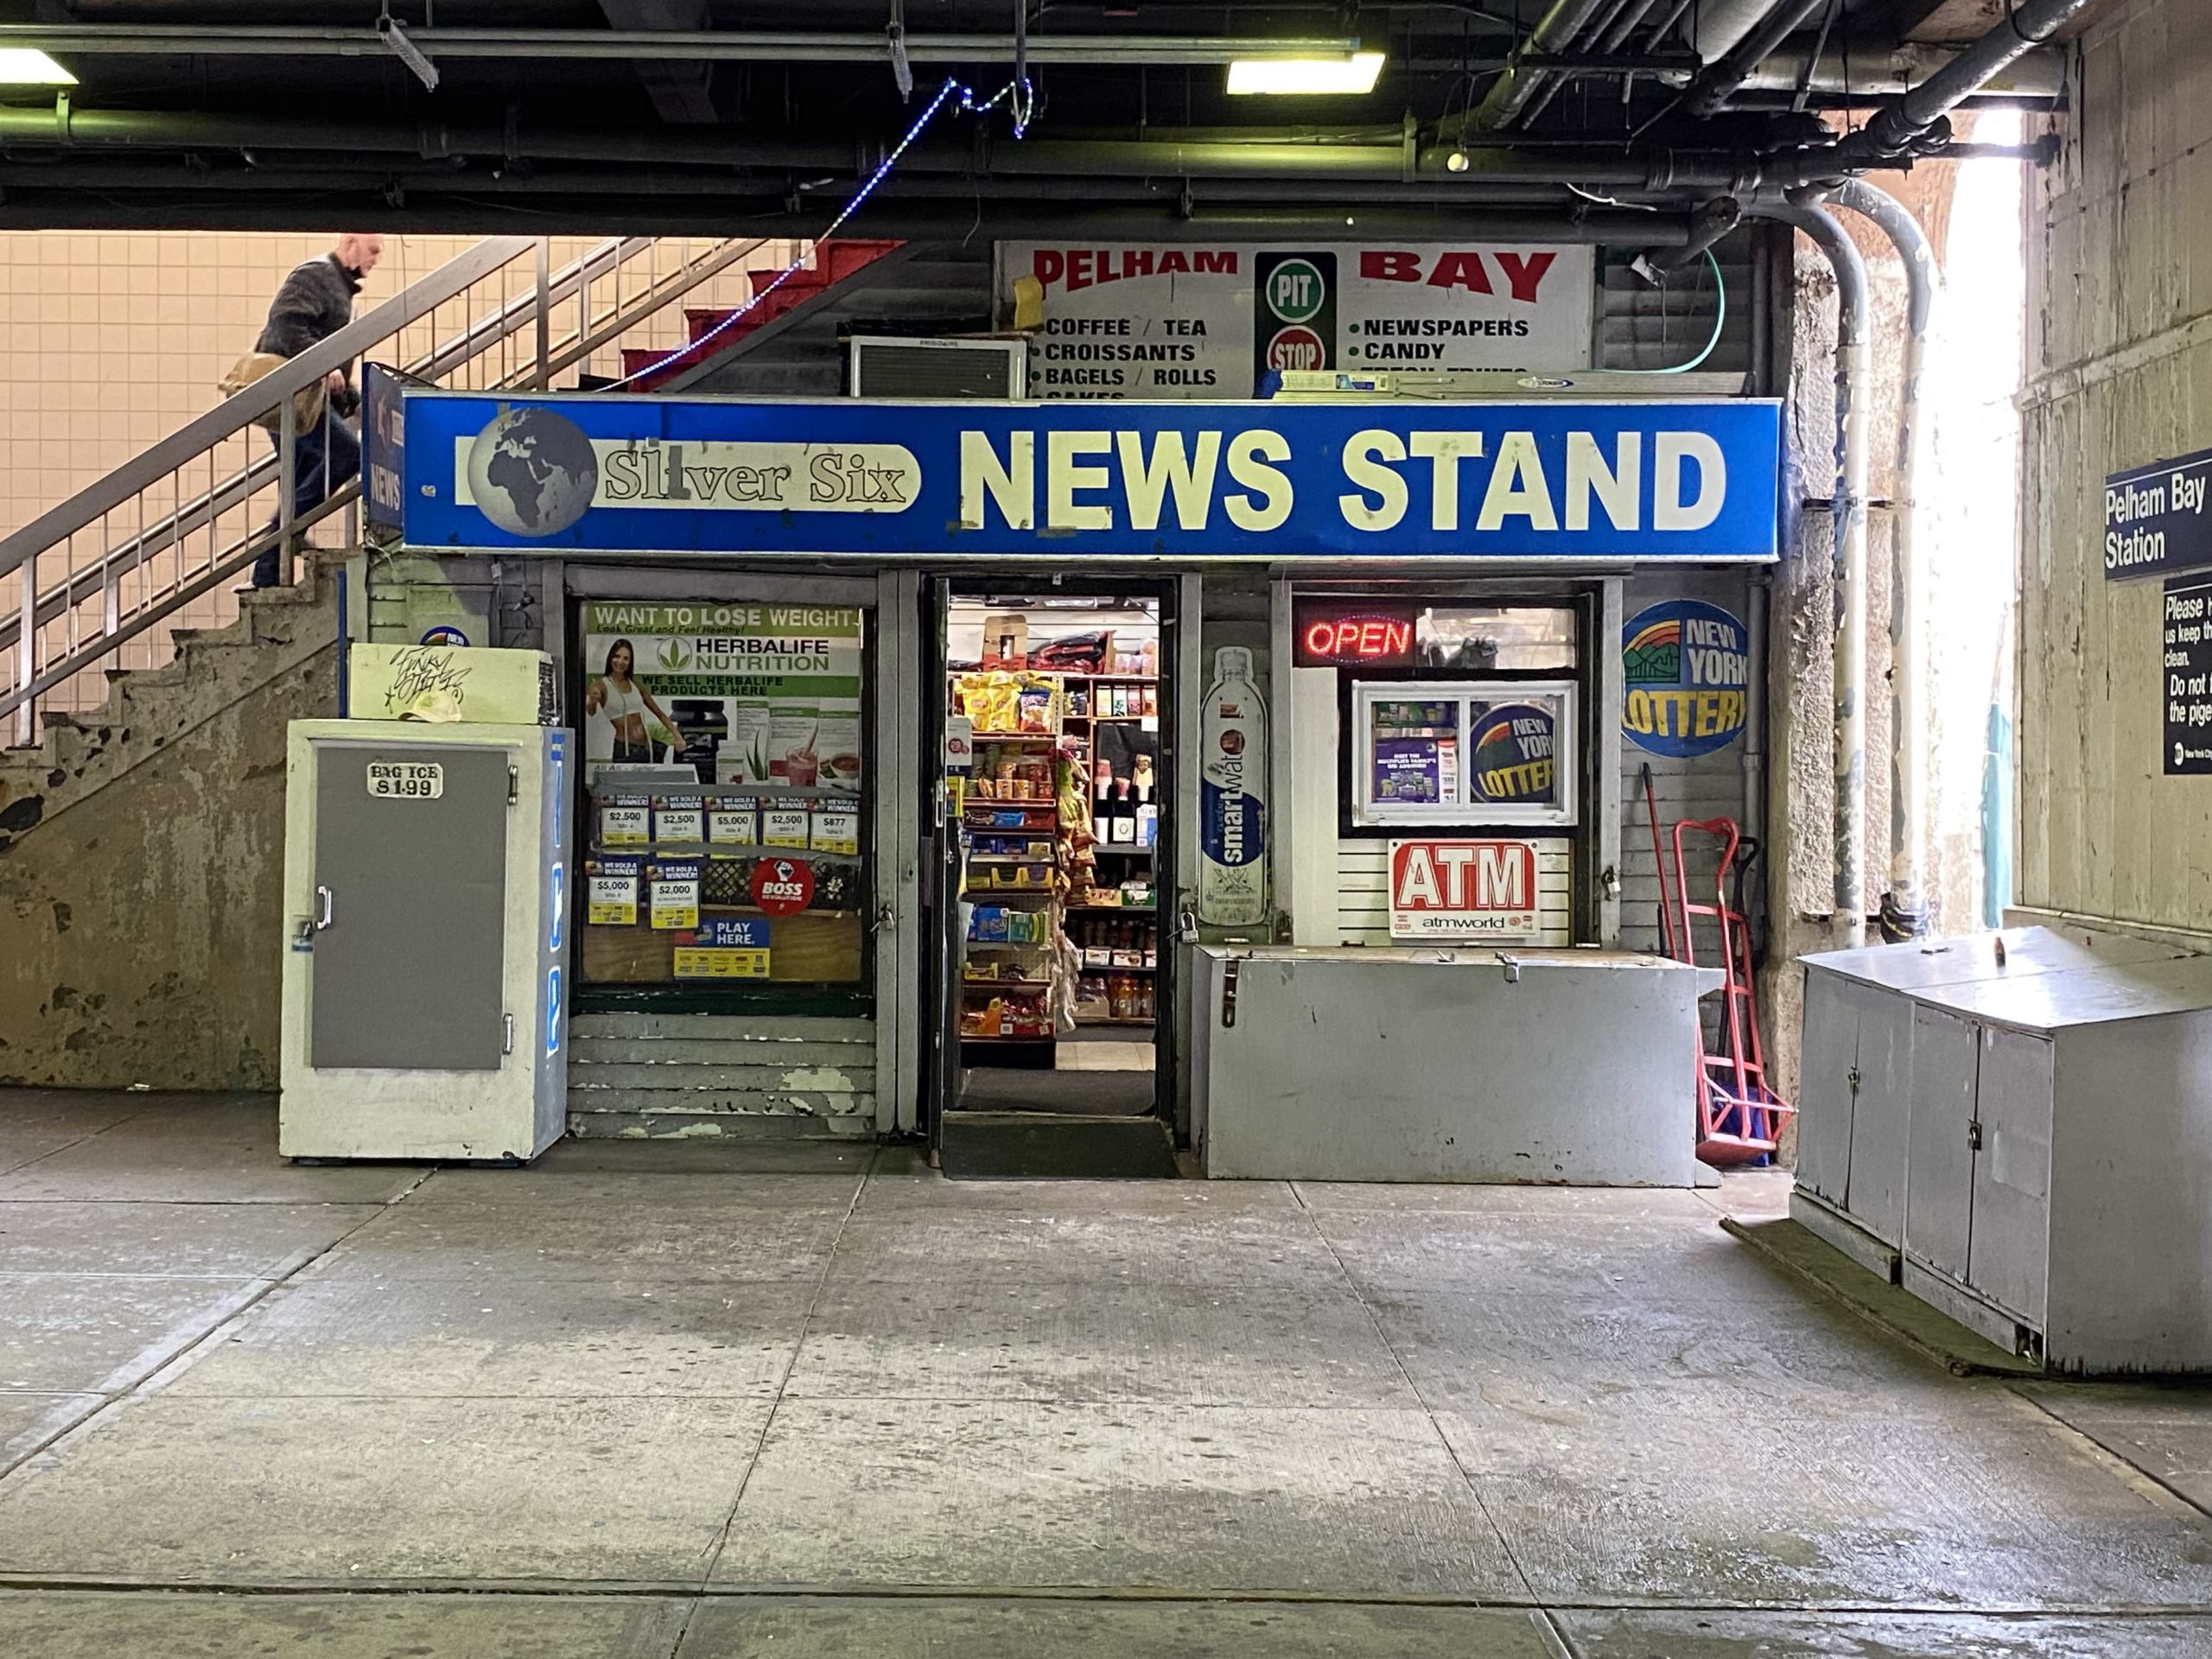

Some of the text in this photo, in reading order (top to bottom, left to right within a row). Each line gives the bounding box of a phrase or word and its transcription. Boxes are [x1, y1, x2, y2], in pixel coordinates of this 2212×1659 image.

[1033, 250, 1557, 302] PELHAM BAY
[1277, 275, 1312, 308] PIT
[1046, 317, 1130, 335] COFFEE
[1163, 319, 1207, 336] TEA
[1363, 320, 1529, 336] NEWSPAPERS
[1045, 343, 1195, 361] CROISSANTS
[1274, 342, 1316, 371] STOP
[1363, 342, 1446, 359] CANDY
[1045, 368, 1124, 386] BAGELS
[1154, 369, 1217, 386] ROLLS
[371, 462, 401, 512] NEWS
[810, 453, 906, 503] Six
[960, 429, 1726, 531] NEWS STAND
[2105, 473, 2207, 525] Pelham Bay
[2105, 530, 2165, 569] Station
[594, 607, 853, 627] WANT TO LOSE WEIGHT
[2165, 595, 2204, 621] Please
[596, 625, 621, 633] Look
[625, 626, 652, 634] Great
[678, 626, 700, 634] Feel
[702, 626, 745, 635] Healthy!
[1307, 623, 1411, 655] OPEN
[1687, 619, 1737, 650] NEW
[2164, 620, 2212, 645] us keep th
[696, 639, 830, 654] HERBALIFE
[696, 656, 830, 671] NUTRITION
[2164, 648, 2190, 668] clean.
[642, 675, 784, 687] WE SELL HERBALIFE
[651, 685, 767, 696] PRODUCTS HERE
[2170, 674, 2185, 696] Do
[2188, 672, 2206, 696] not
[2169, 698, 2212, 728] the pige
[1512, 718, 1548, 736] NEW
[1516, 734, 1554, 760] YOR
[371, 766, 438, 779] BAG ICE
[1477, 759, 1554, 798] LOTTER
[1224, 753, 1244, 863] smartwat
[663, 815, 695, 823] $2,500
[772, 815, 803, 825] $2,500
[823, 817, 846, 827] $877
[1398, 844, 1526, 907] ATM
[597, 881, 629, 891] $5,000
[658, 885, 690, 894] $2,000
[761, 881, 804, 896] BOSS
[716, 922, 751, 933] PLAY
[1422, 917, 1504, 929] atmworld
